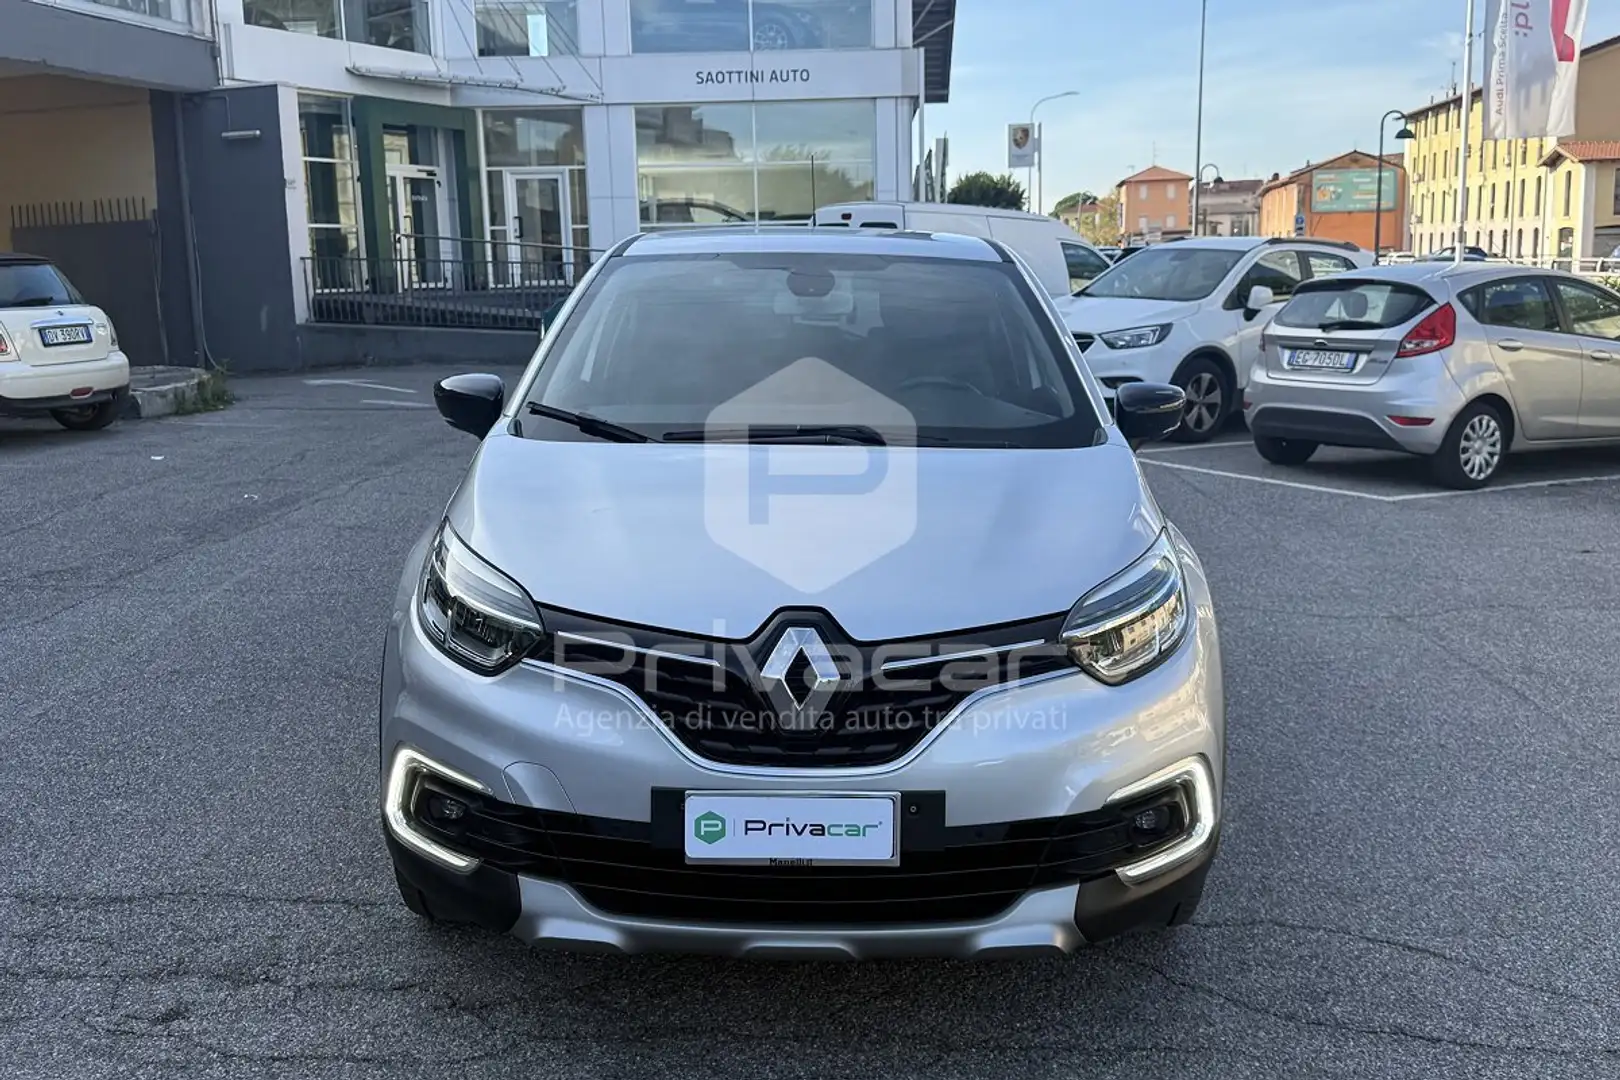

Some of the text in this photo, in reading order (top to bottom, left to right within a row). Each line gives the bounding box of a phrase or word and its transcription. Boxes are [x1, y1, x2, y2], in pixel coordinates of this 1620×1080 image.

[1495, 13, 1508, 115] Audi Prima Scelta
[696, 69, 810, 85] SAOTTINI AUTO
[700, 817, 879, 837] P Privacar
